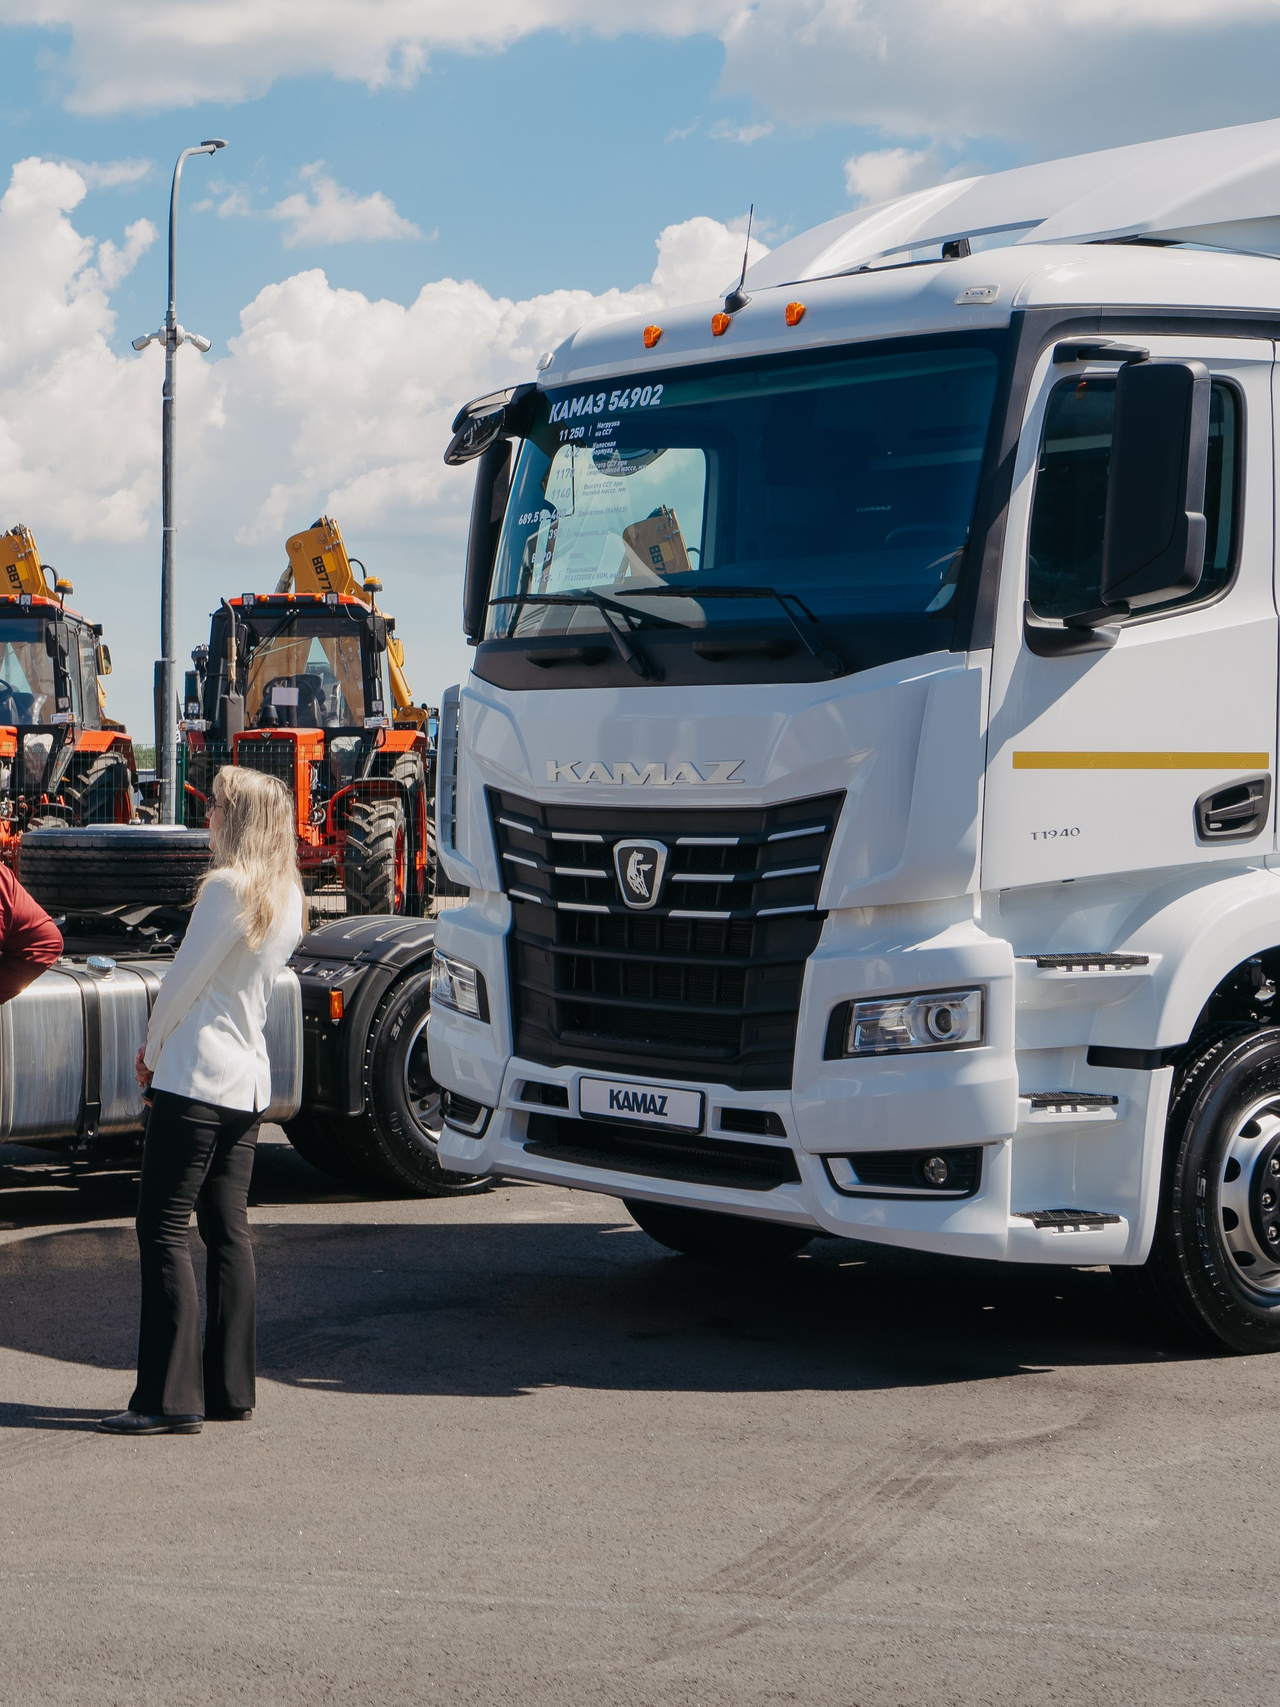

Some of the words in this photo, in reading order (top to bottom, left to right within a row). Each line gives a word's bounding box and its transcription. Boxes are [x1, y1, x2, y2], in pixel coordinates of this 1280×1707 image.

[548, 392, 606, 424] КАМАЗ
[608, 384, 664, 411] 54902
[596, 420, 621, 430] Нагрузка
[570, 426, 585, 439] 250
[602, 428, 613, 436] ССУ
[551, 487, 571, 500] 1140
[546, 759, 745, 786] KAMAZ
[609, 1088, 668, 1117] KAMAZ
